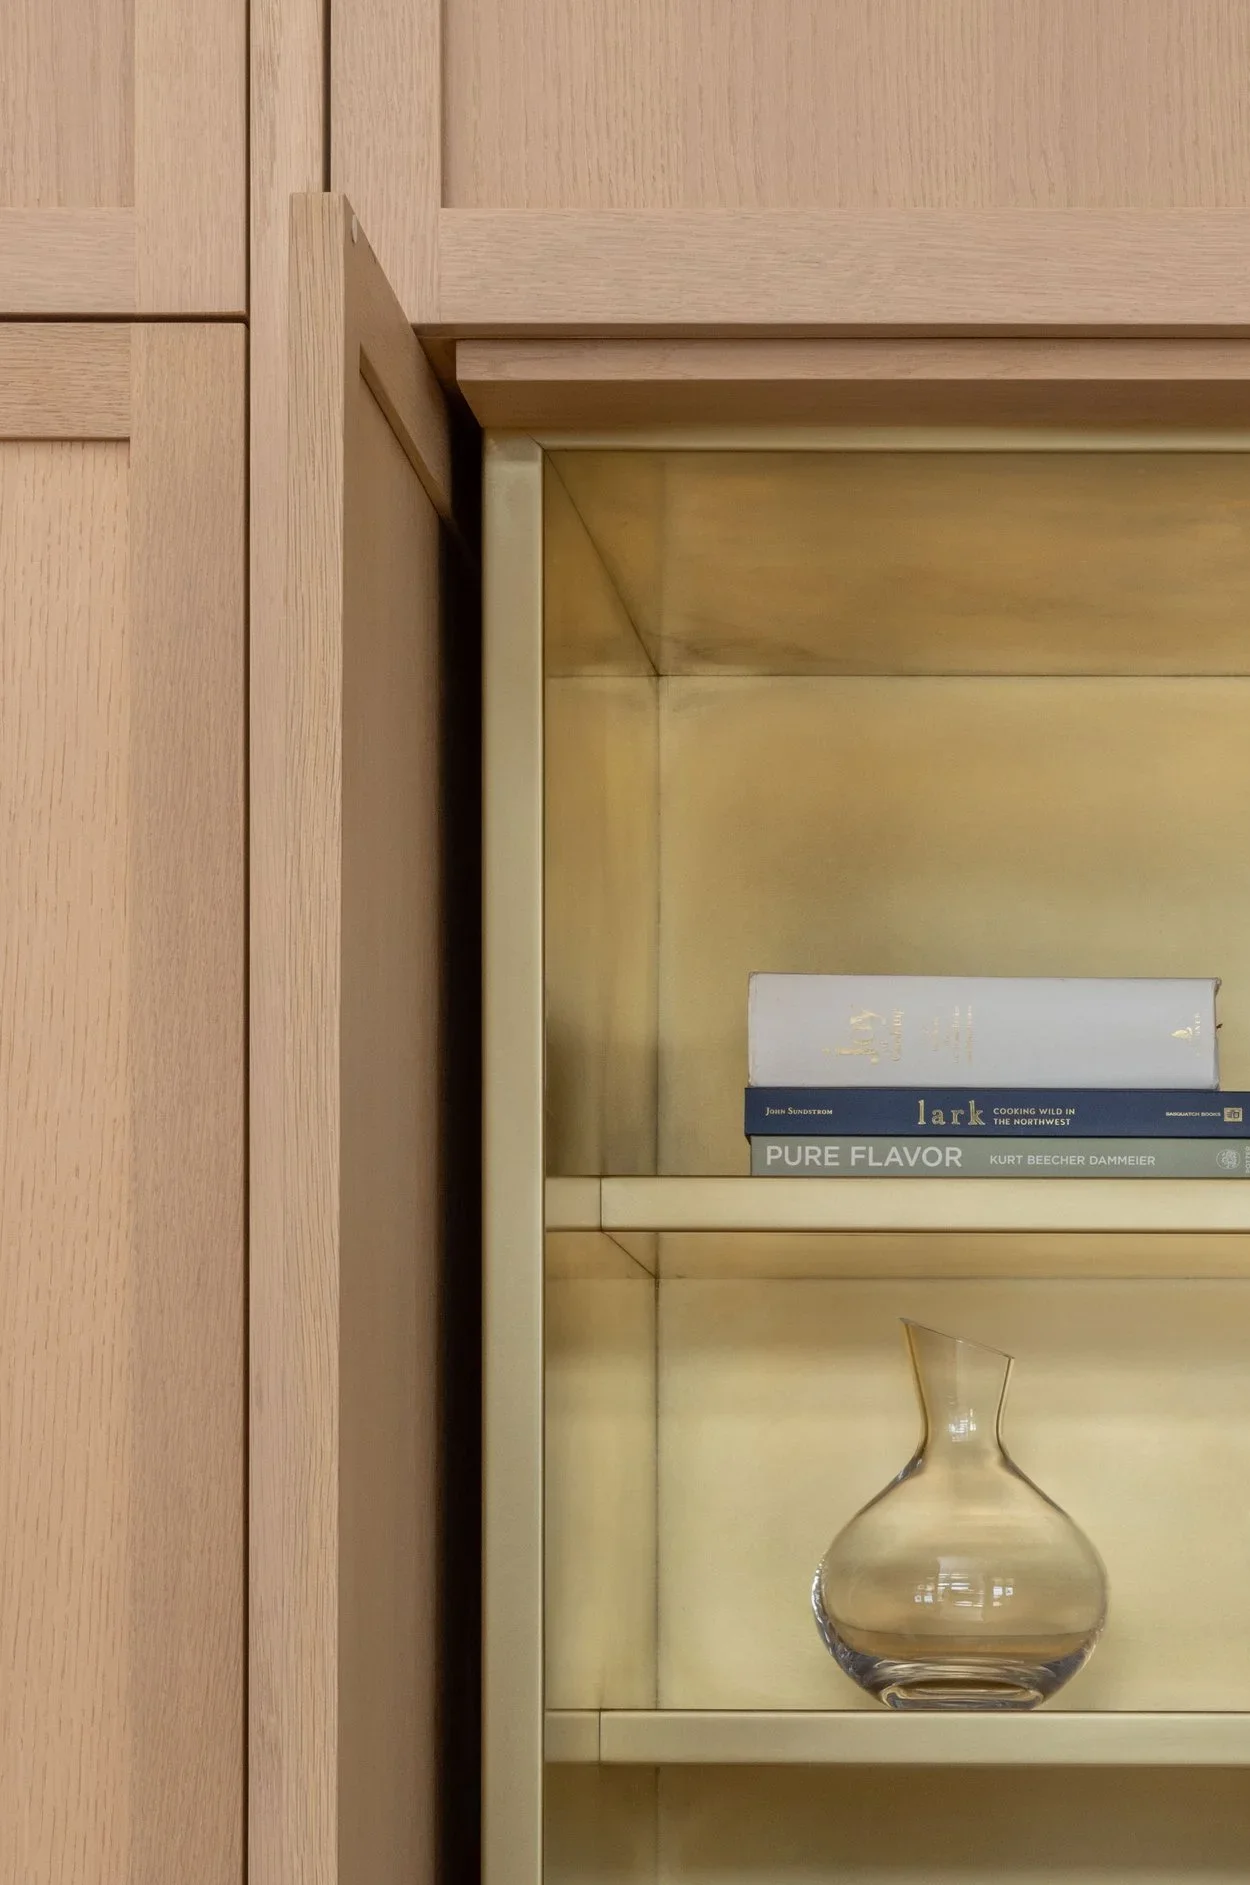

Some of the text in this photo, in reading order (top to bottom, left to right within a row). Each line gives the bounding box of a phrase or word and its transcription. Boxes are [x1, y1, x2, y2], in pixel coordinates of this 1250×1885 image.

[917, 1099, 986, 1126] lark
[993, 1107, 1076, 1116] COOKING WILD IN
[993, 1118, 1071, 1126] THE NORTHWEST
[765, 1146, 963, 1168] PURE FLAVOR
[990, 1155, 1156, 1167] KURT BEECHER DAMMEIER
